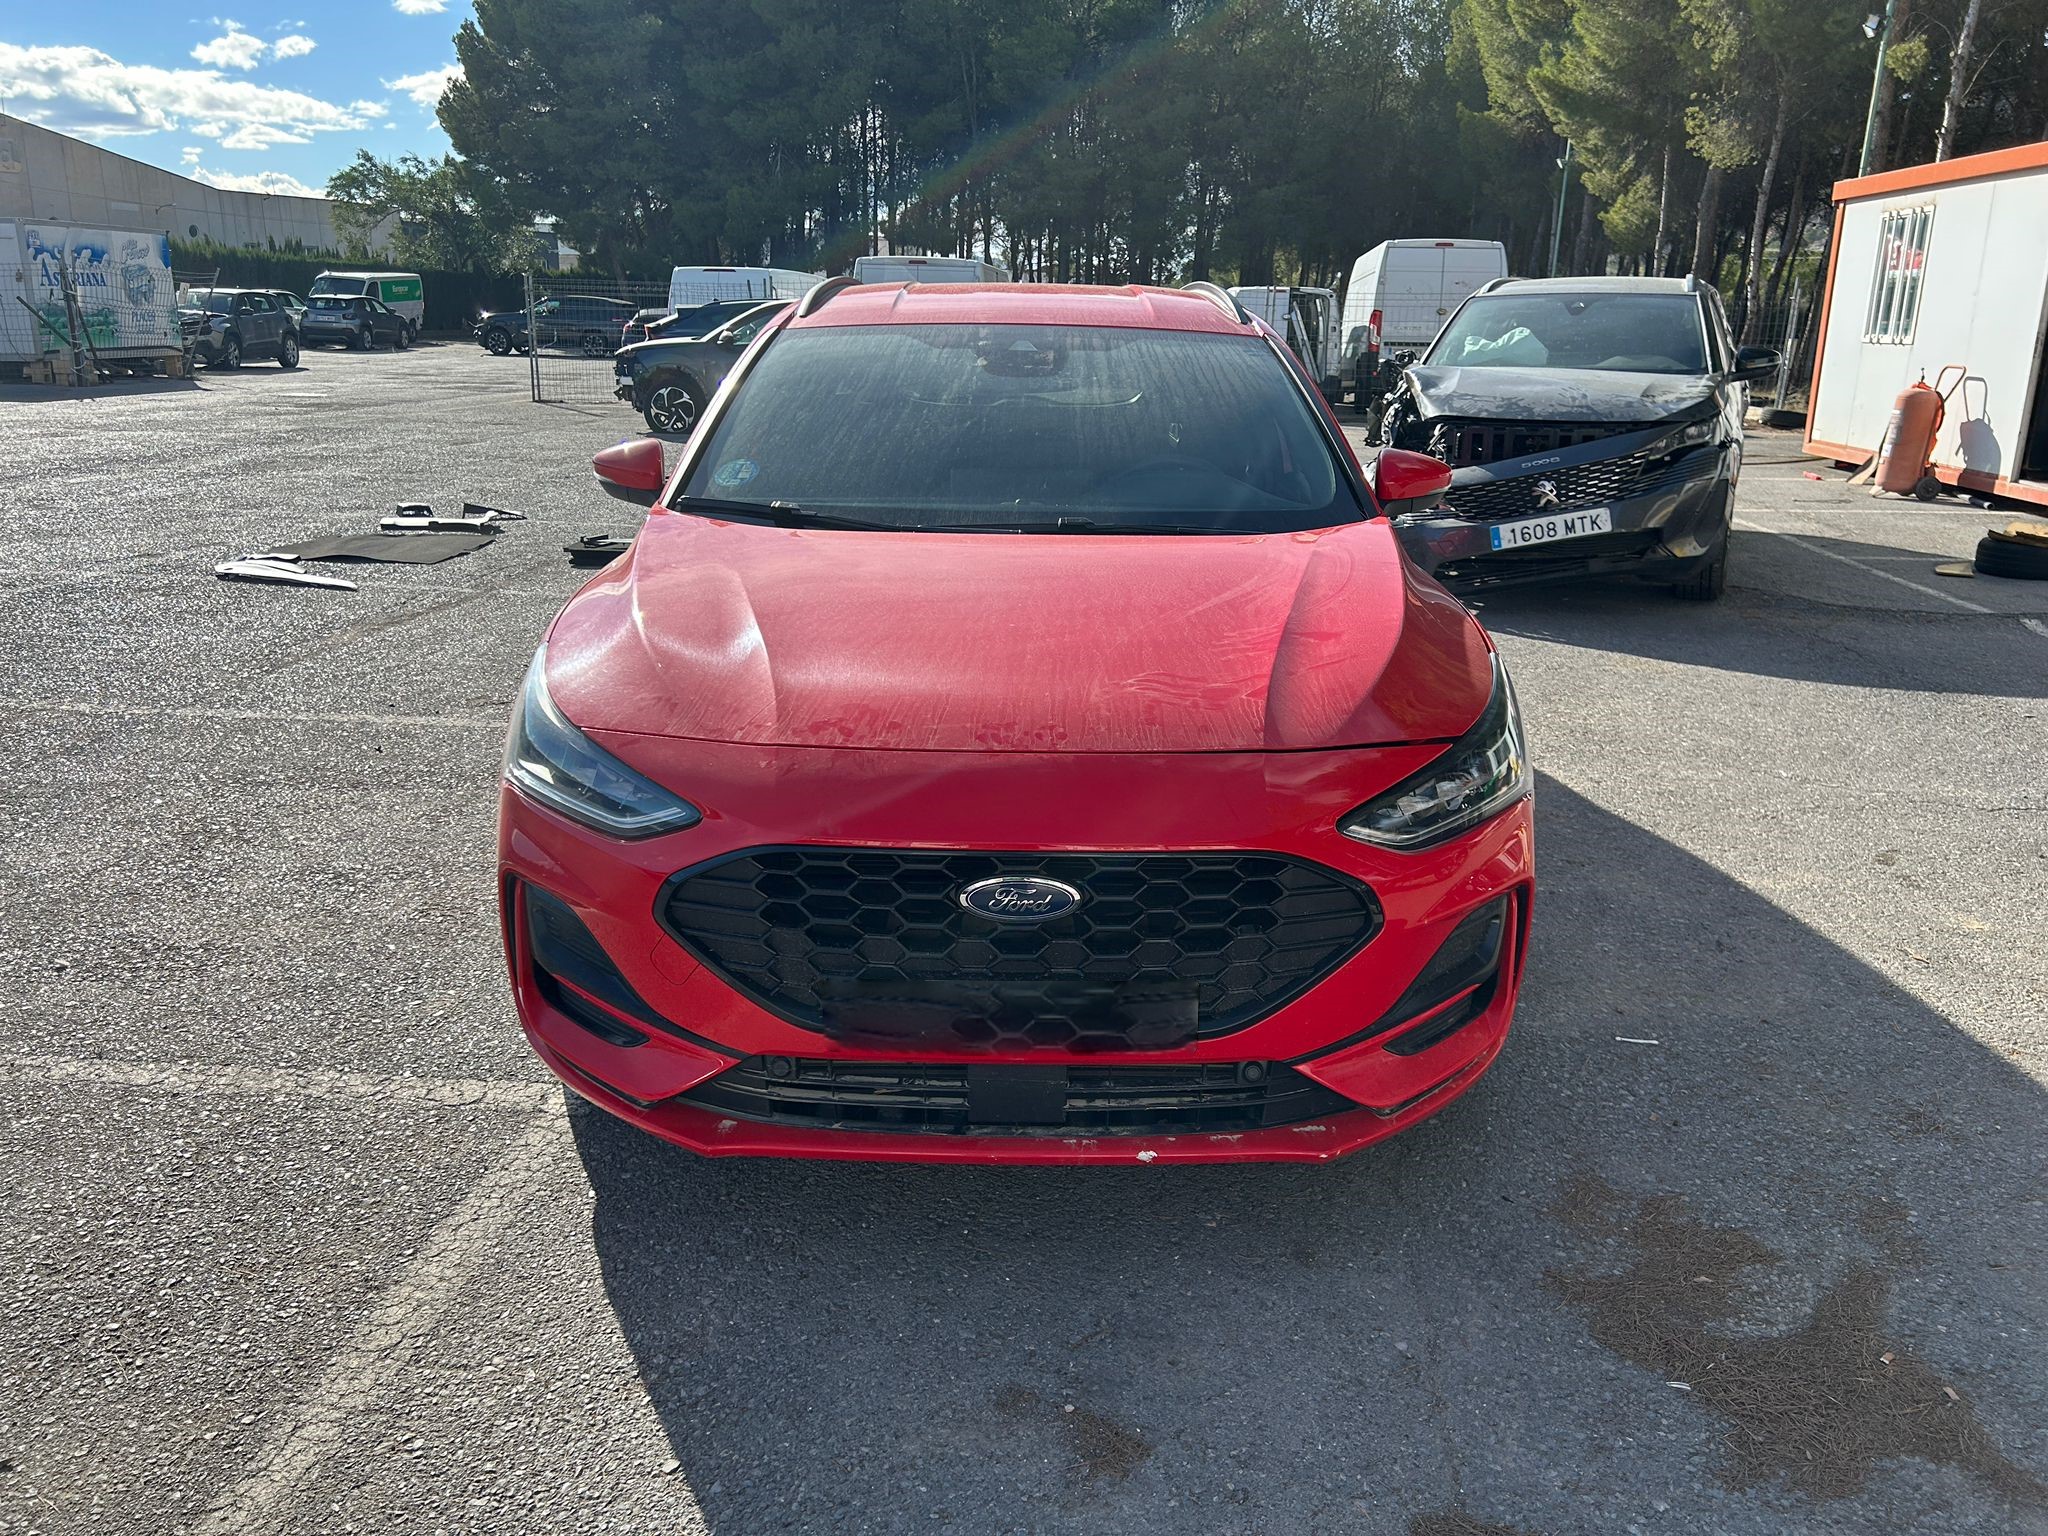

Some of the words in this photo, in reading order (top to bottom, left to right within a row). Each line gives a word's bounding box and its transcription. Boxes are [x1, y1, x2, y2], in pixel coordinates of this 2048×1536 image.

[1510, 521, 1557, 545] 1608
[1564, 514, 1602, 536] MTK
[988, 887, 1052, 912] Ford
